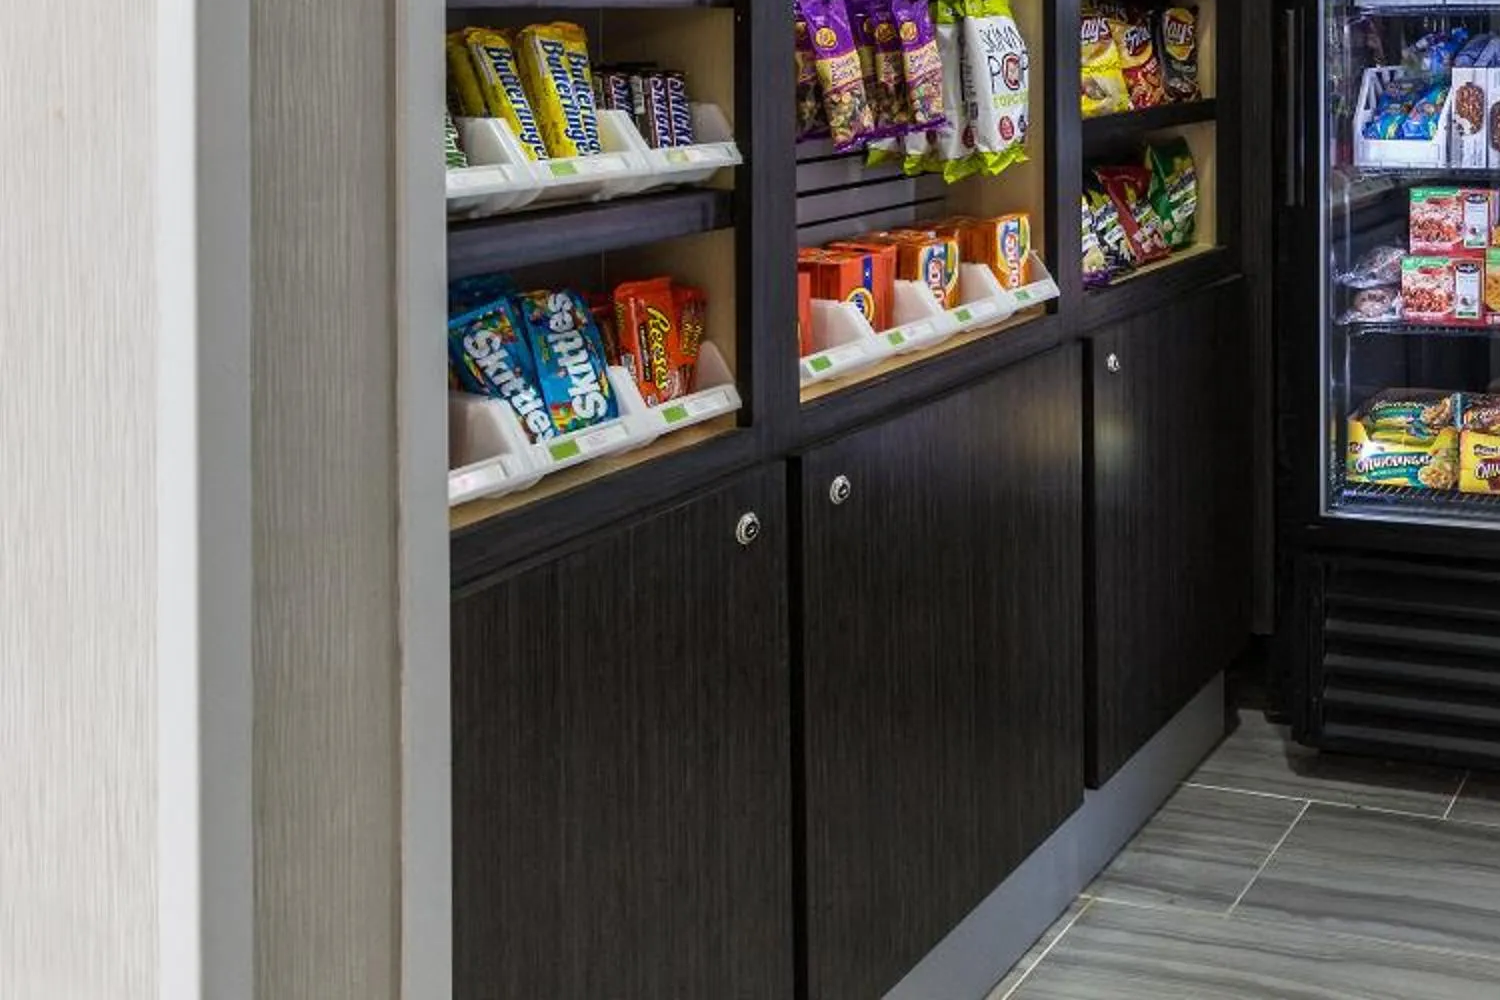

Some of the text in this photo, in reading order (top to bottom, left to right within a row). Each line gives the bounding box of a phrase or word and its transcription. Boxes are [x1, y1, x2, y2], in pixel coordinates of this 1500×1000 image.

[1081, 17, 1109, 43] ay's
[547, 293, 607, 420] Skittles
[647, 307, 670, 390] Reese's
